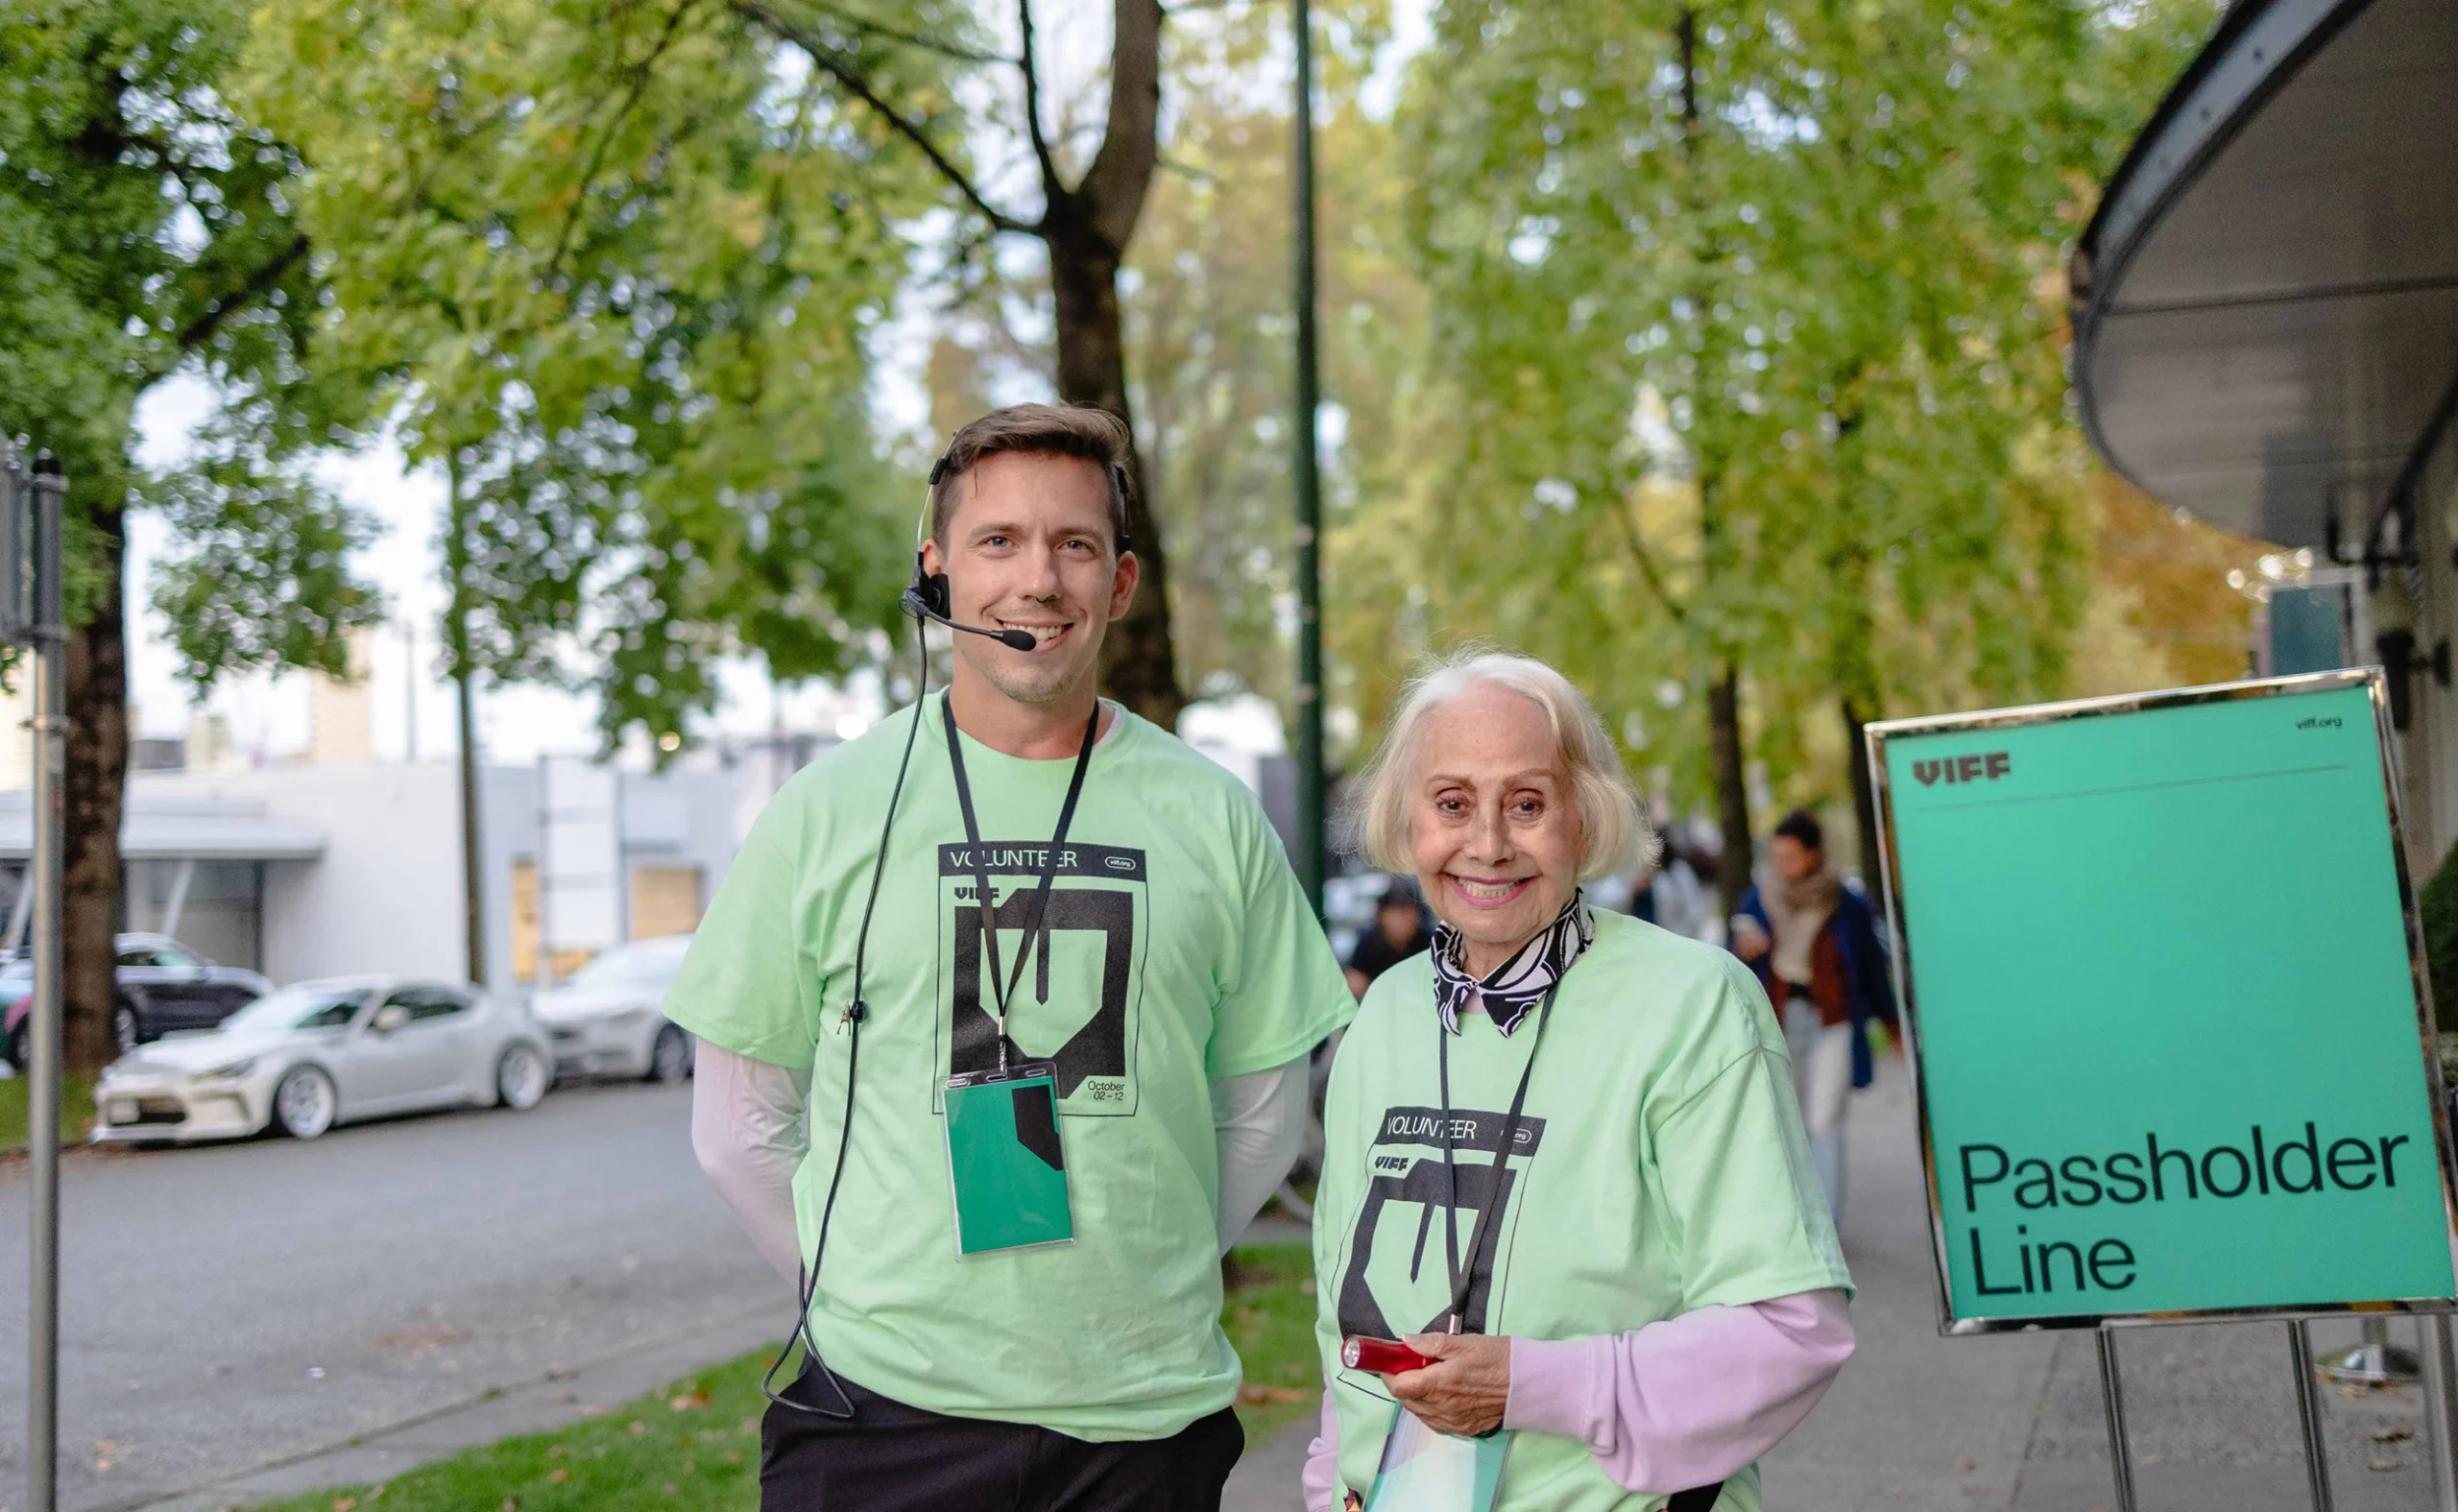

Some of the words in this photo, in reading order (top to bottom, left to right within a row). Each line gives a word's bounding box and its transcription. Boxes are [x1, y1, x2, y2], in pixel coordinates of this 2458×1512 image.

[2295, 716, 2343, 730] viff.org
[1912, 752, 2012, 787] VIFF
[954, 886, 1000, 900] VIF
[1087, 1080, 1125, 1091] October
[1093, 1091, 1105, 1100] 02
[1115, 1092, 1124, 1101] 12
[1374, 1156, 1410, 1171] VIFF
[1959, 1121, 2409, 1212] Passholder
[1969, 1225, 2136, 1296] Line
